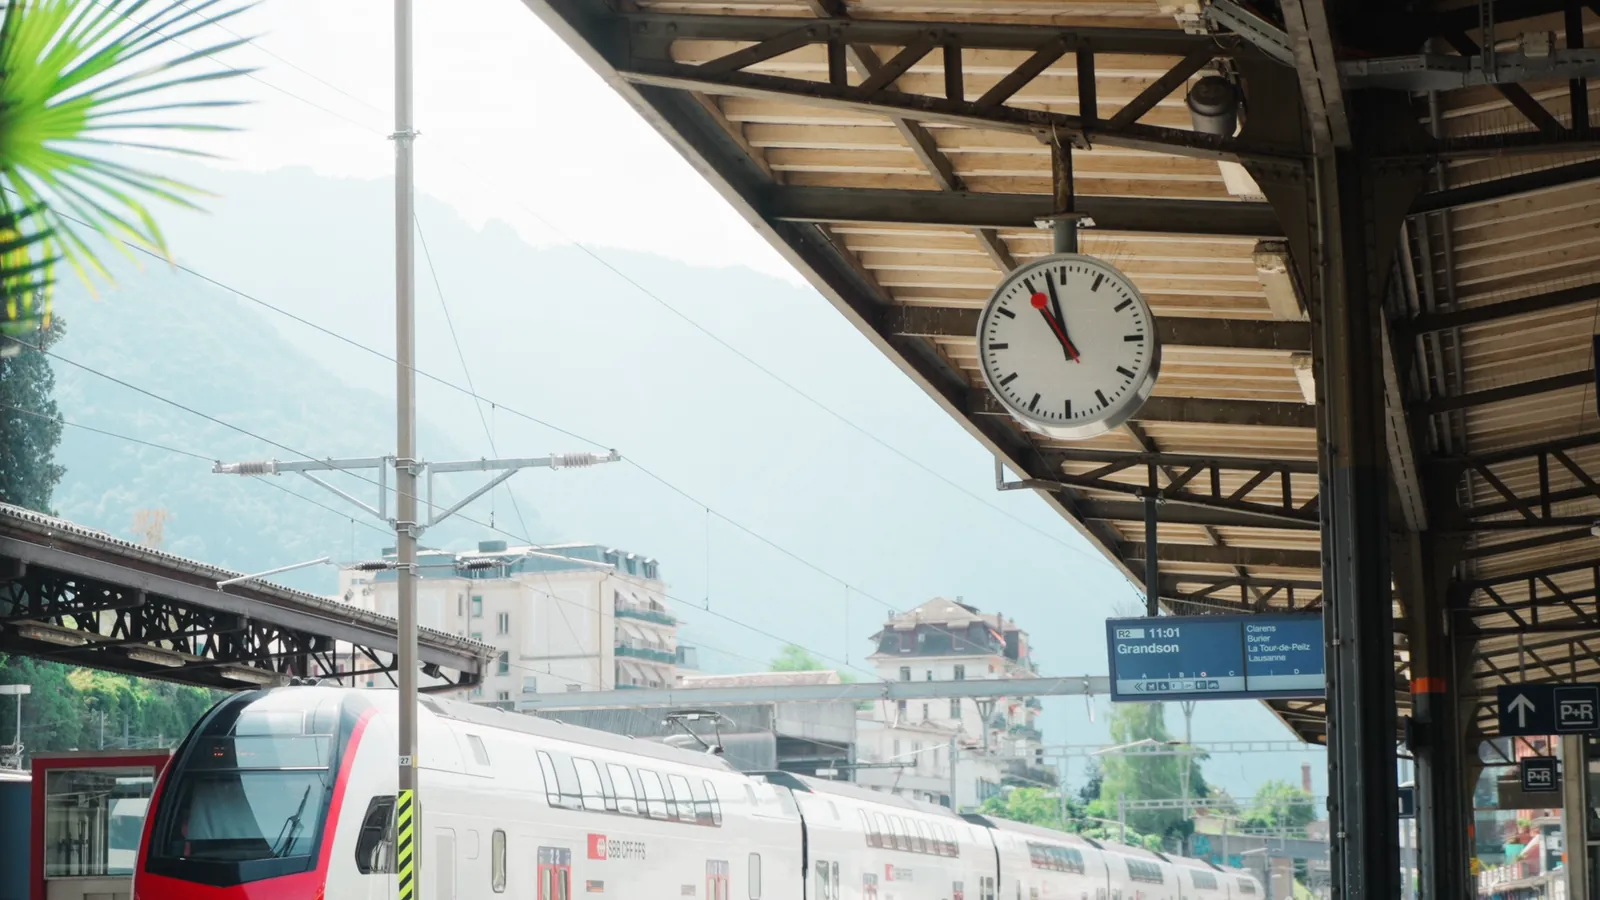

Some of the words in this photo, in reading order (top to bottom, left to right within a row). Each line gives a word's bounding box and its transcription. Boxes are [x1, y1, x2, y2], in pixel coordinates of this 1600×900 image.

[1118, 630, 1131, 638] R2
[1149, 627, 1180, 638] 11:01
[1246, 625, 1277, 633] Clarens
[1247, 634, 1271, 643] Burier
[1117, 643, 1180, 654] Grandson
[1247, 645, 1258, 653] La
[1248, 654, 1286, 662] Lausanne
[1560, 703, 1594, 720] P+R
[400, 757, 409, 765] 27
[1527, 770, 1551, 782] P+R
[607, 839, 621, 859] SBB
[621, 841, 634, 859] CFF
[634, 842, 647, 860] FFS
